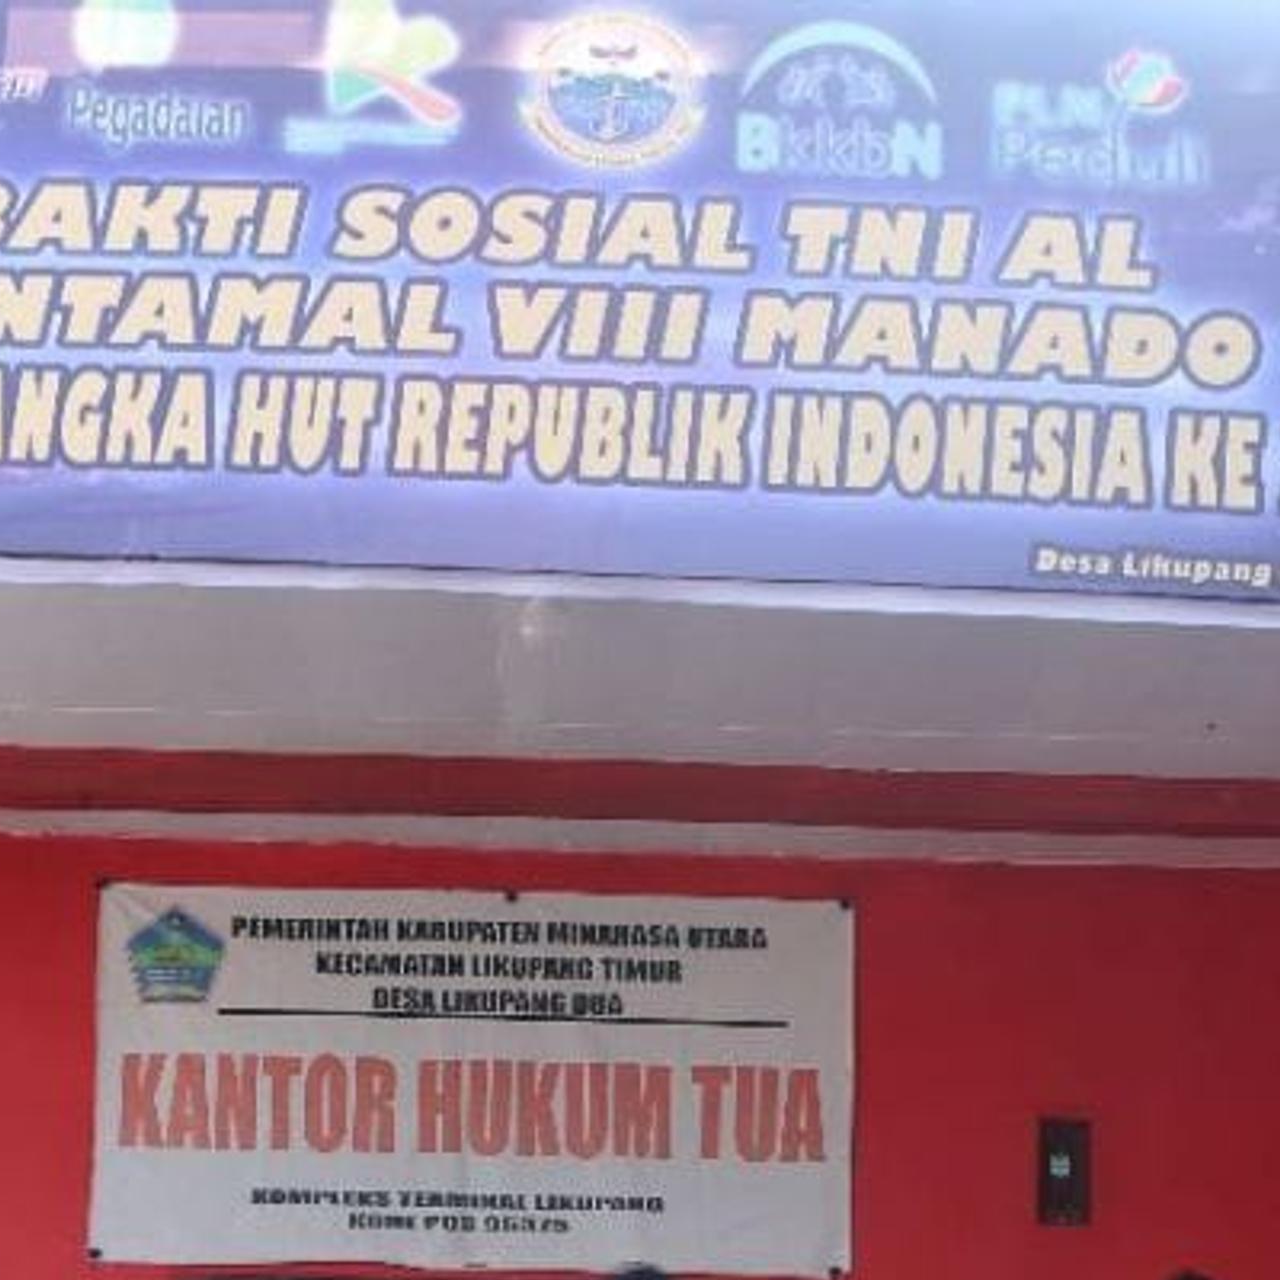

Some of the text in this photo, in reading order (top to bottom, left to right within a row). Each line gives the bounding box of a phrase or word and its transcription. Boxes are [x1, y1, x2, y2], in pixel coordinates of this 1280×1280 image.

[332, 186, 754, 270] SOSIAL
[785, 203, 978, 280] TNI
[999, 212, 1158, 290] AL
[489, 285, 707, 363] VIII
[736, 292, 1264, 390] MANADO
[226, 371, 384, 472] HUT
[392, 376, 756, 486] REPUBLIK
[762, 393, 1152, 508] INDONESIA
[1164, 408, 1266, 513] KE
[1035, 547, 1110, 575] Desa
[1122, 552, 1272, 587] Likupang
[231, 917, 768, 950] PEMERINTAH KABUPATEN MINAHASA UTARA
[316, 952, 683, 983] KECAMATAN LIKUPANG TIMUR
[372, 986, 624, 1016] DESA LIKUPANG DUA
[119, 1052, 827, 1163] KANTOR HUKUM TUA
